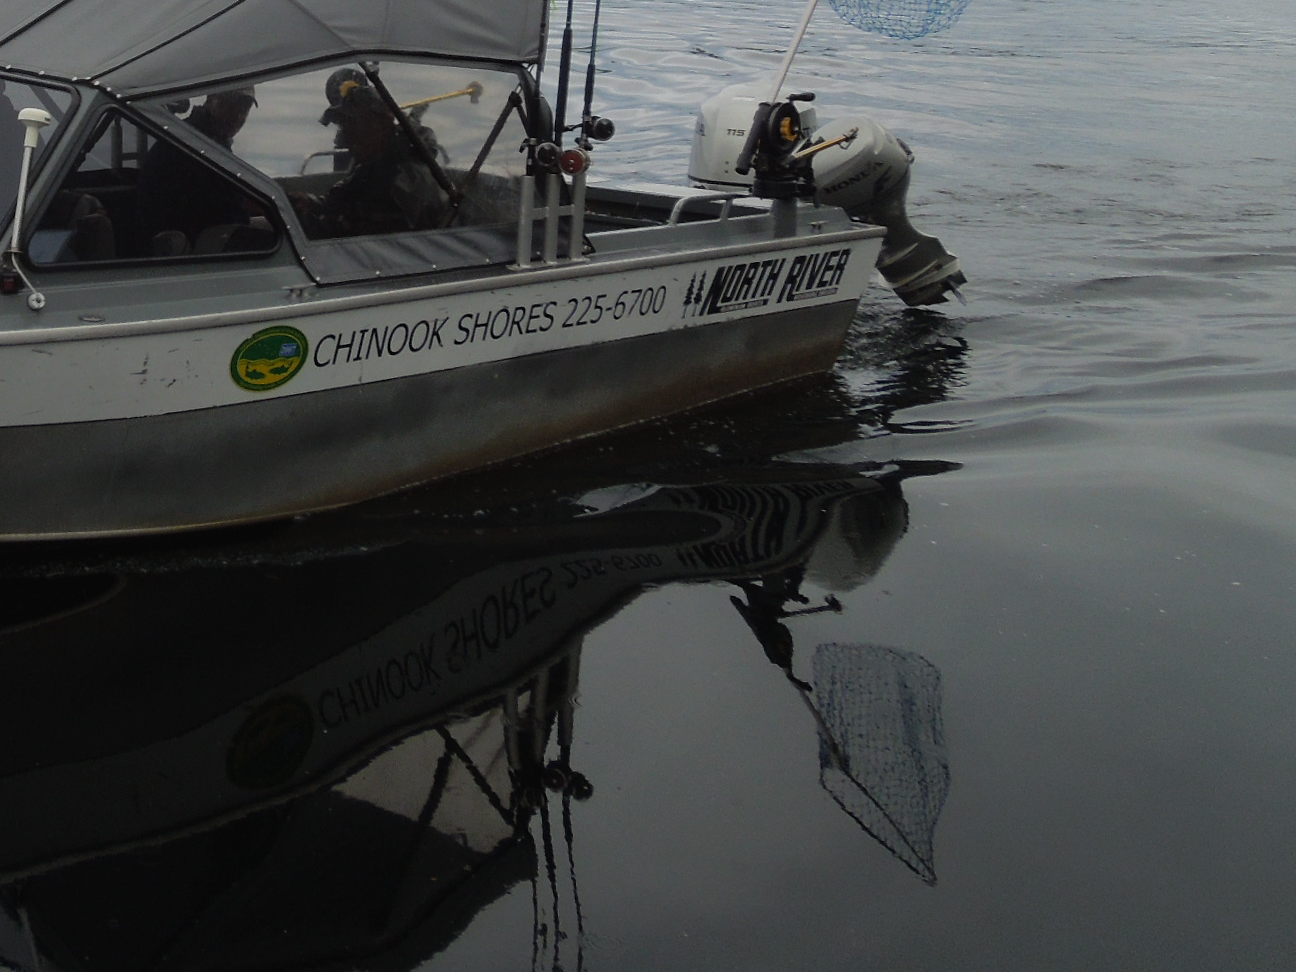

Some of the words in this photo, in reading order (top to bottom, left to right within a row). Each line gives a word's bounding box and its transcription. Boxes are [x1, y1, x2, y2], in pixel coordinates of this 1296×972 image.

[726, 128, 746, 137] 115
[699, 258, 787, 316] NORTH
[776, 248, 852, 304] RIVER
[313, 316, 450, 368] CHINOOK
[453, 301, 558, 346] SHORES
[561, 285, 668, 329] 225-6700
